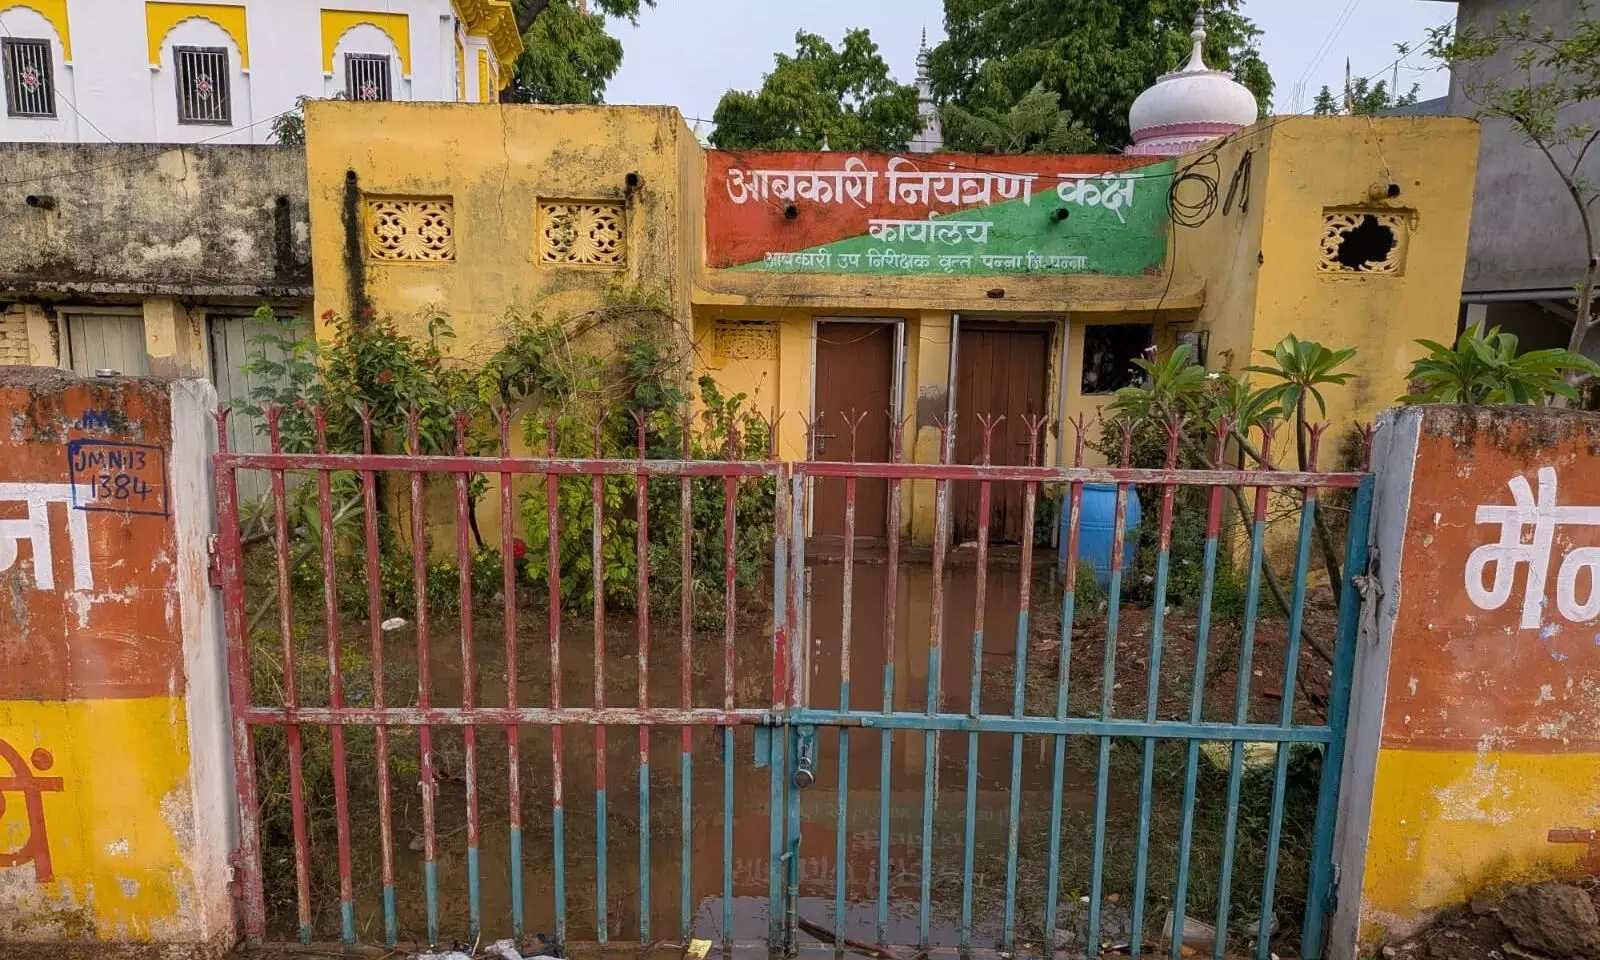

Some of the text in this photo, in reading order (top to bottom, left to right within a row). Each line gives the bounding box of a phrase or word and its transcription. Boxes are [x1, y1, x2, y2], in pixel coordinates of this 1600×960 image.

[726, 156, 1145, 224] आबकारी नियंत्रण कक्ष
[868, 210, 993, 246] कार्यालय
[764, 247, 832, 269] आबकारी
[838, 253, 861, 269] उप
[866, 248, 931, 272] निरीक्षक
[980, 255, 1023, 270] पन्ना
[91, 474, 153, 502] 1384
